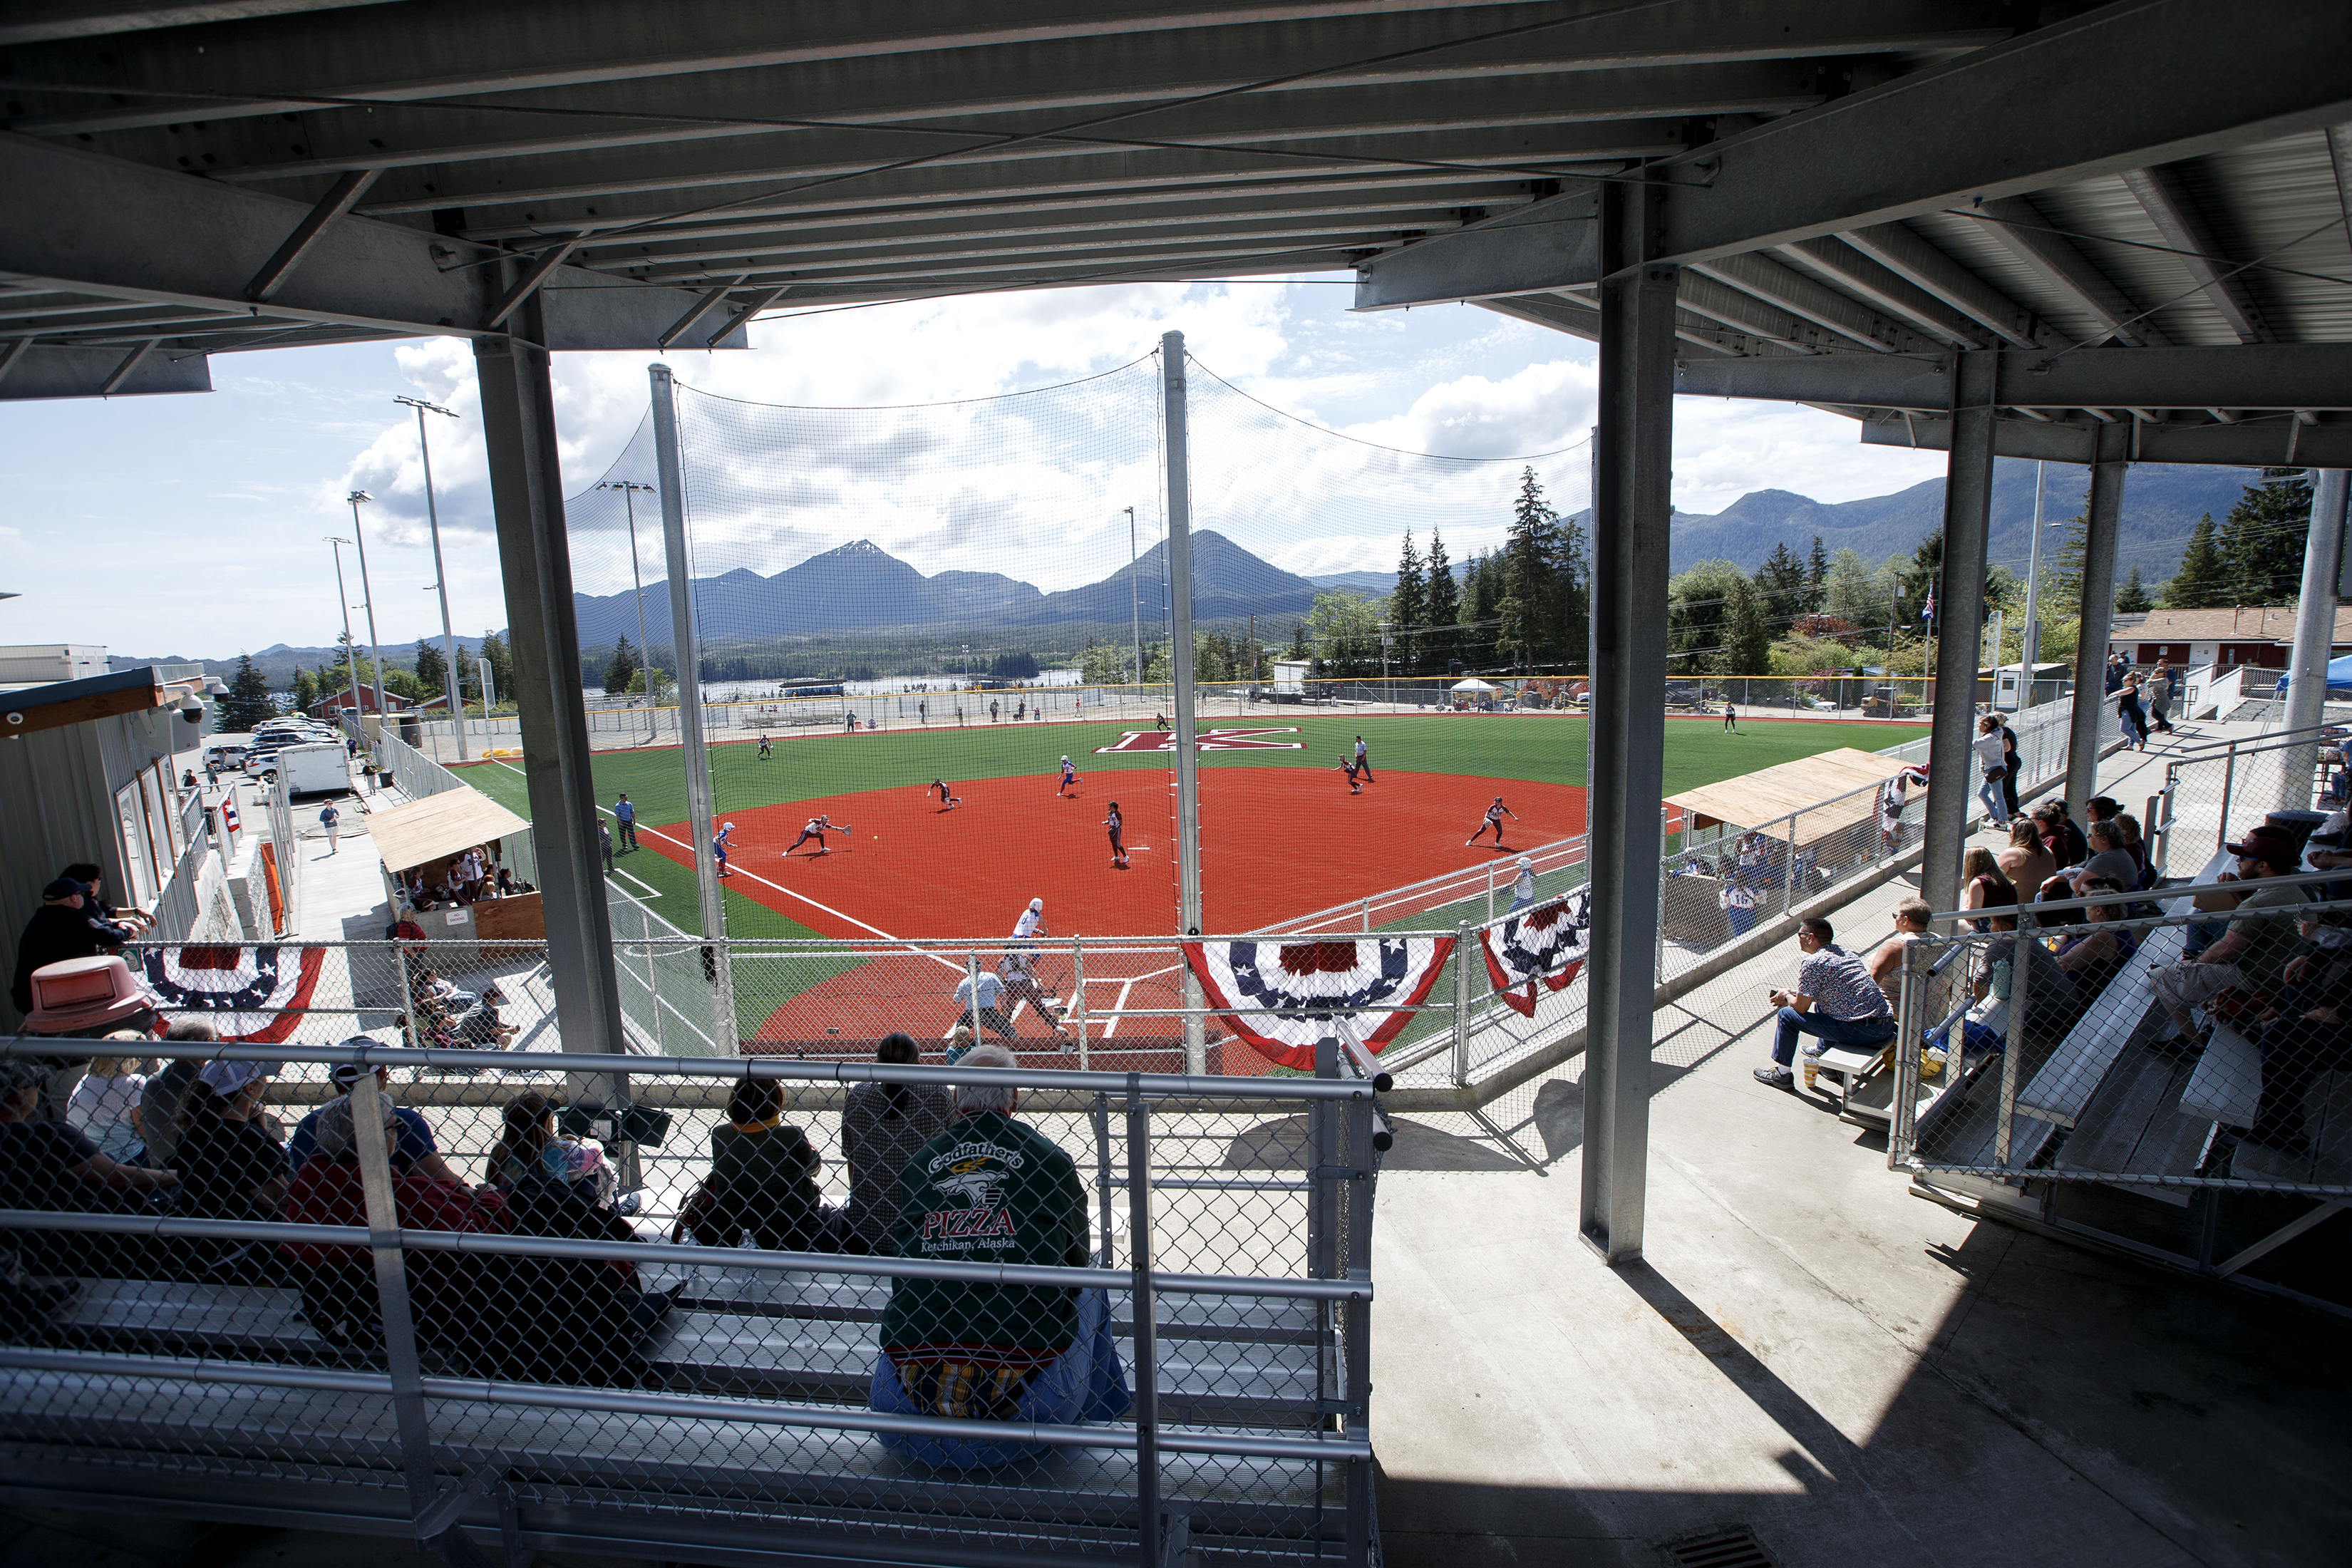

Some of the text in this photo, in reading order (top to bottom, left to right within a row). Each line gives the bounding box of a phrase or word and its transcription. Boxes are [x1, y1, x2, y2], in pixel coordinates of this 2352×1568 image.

[1090, 727, 1308, 753] K
[929, 1142, 1024, 1174] Godfather's
[922, 1207, 1018, 1239] PIZZA
[921, 1237, 1015, 1253] Ketchikan, Alaska
